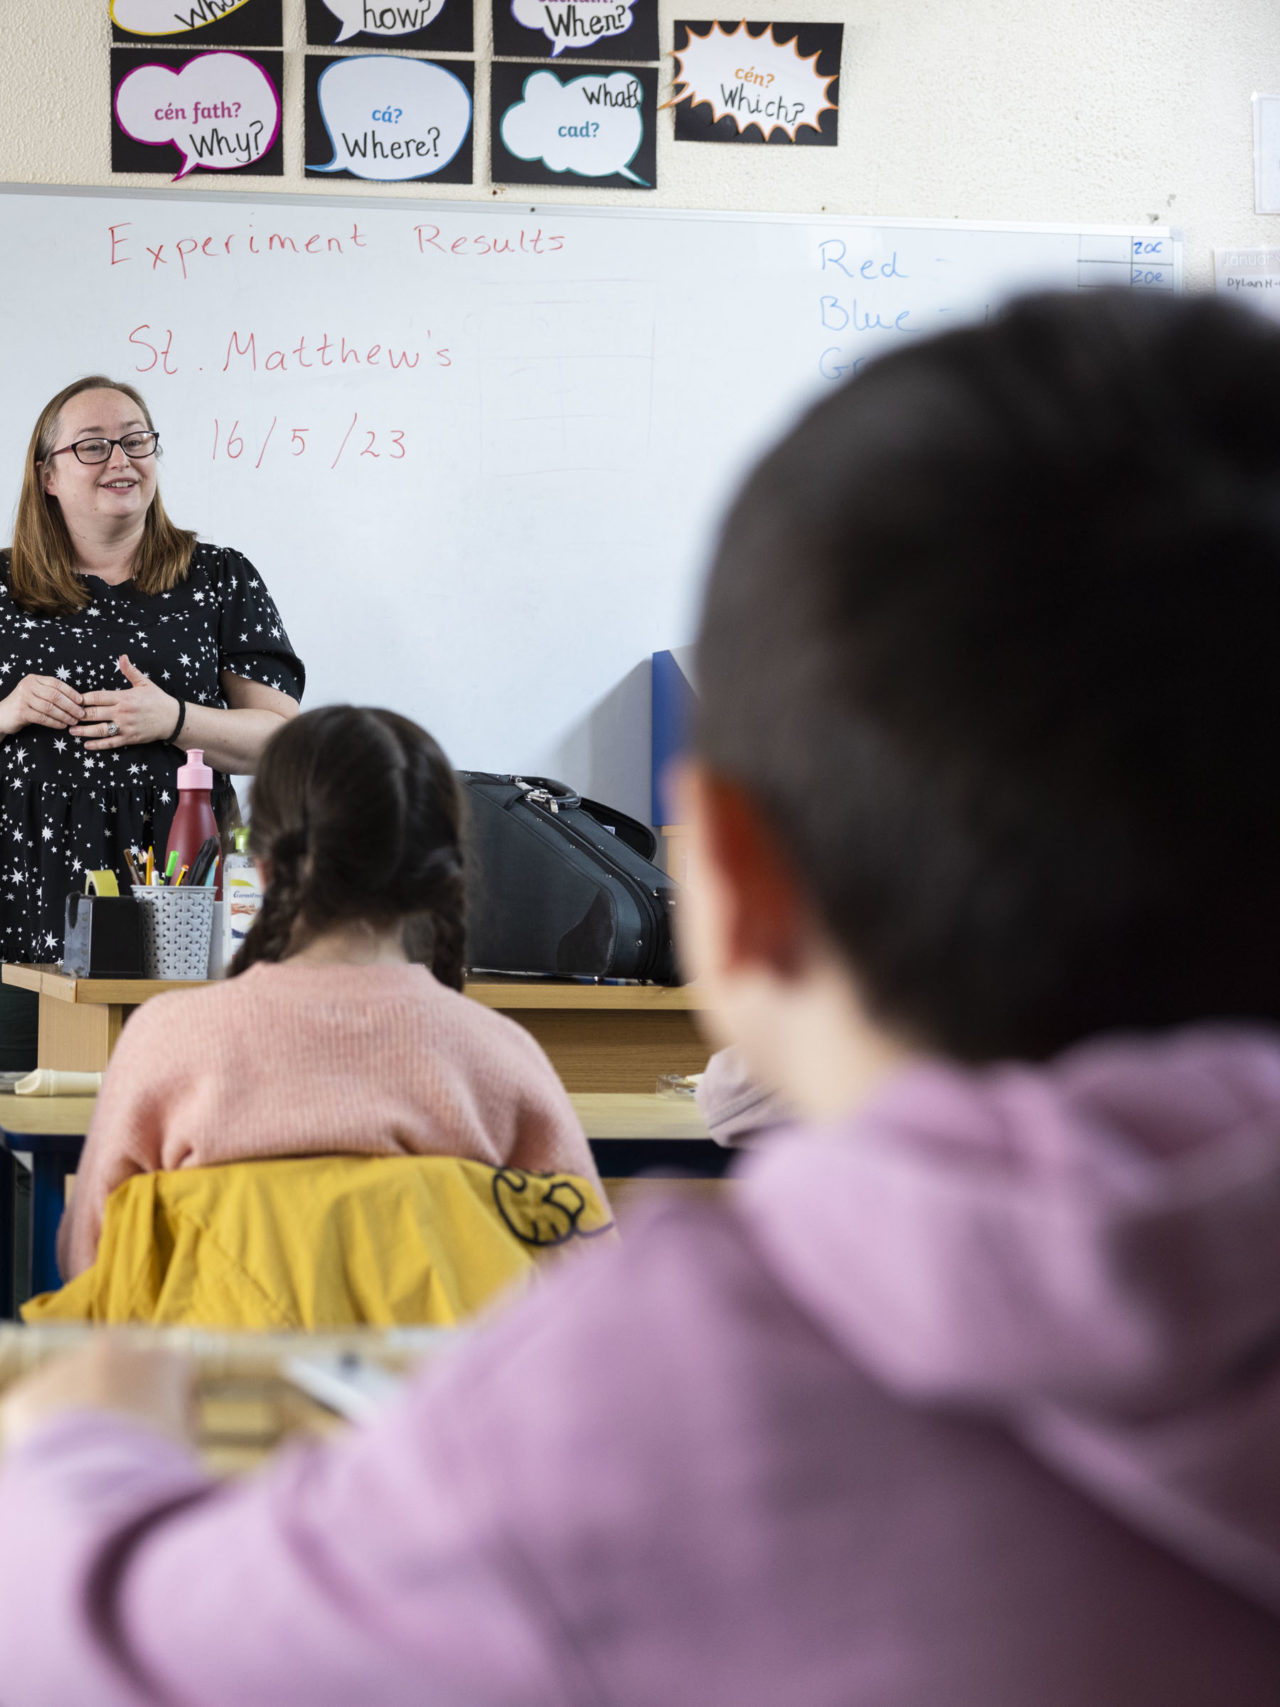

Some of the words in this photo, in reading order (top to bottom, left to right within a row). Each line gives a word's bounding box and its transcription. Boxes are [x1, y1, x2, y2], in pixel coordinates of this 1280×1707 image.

[545, 4, 626, 37] When?
[582, 79, 639, 109] What?
[735, 66, 775, 89] cén?
[154, 102, 186, 121] cén
[192, 101, 241, 124] fath?
[371, 105, 403, 124] cá?
[720, 83, 806, 125] Which?
[190, 120, 264, 163] Why?
[342, 126, 441, 160] Where?
[558, 121, 600, 138] cad?
[108, 222, 368, 279] Experiment
[413, 223, 566, 255] Results
[819, 239, 908, 280] Red
[820, 295, 924, 333] Blue
[129, 324, 204, 375] St.
[222, 329, 453, 373] Matthew's
